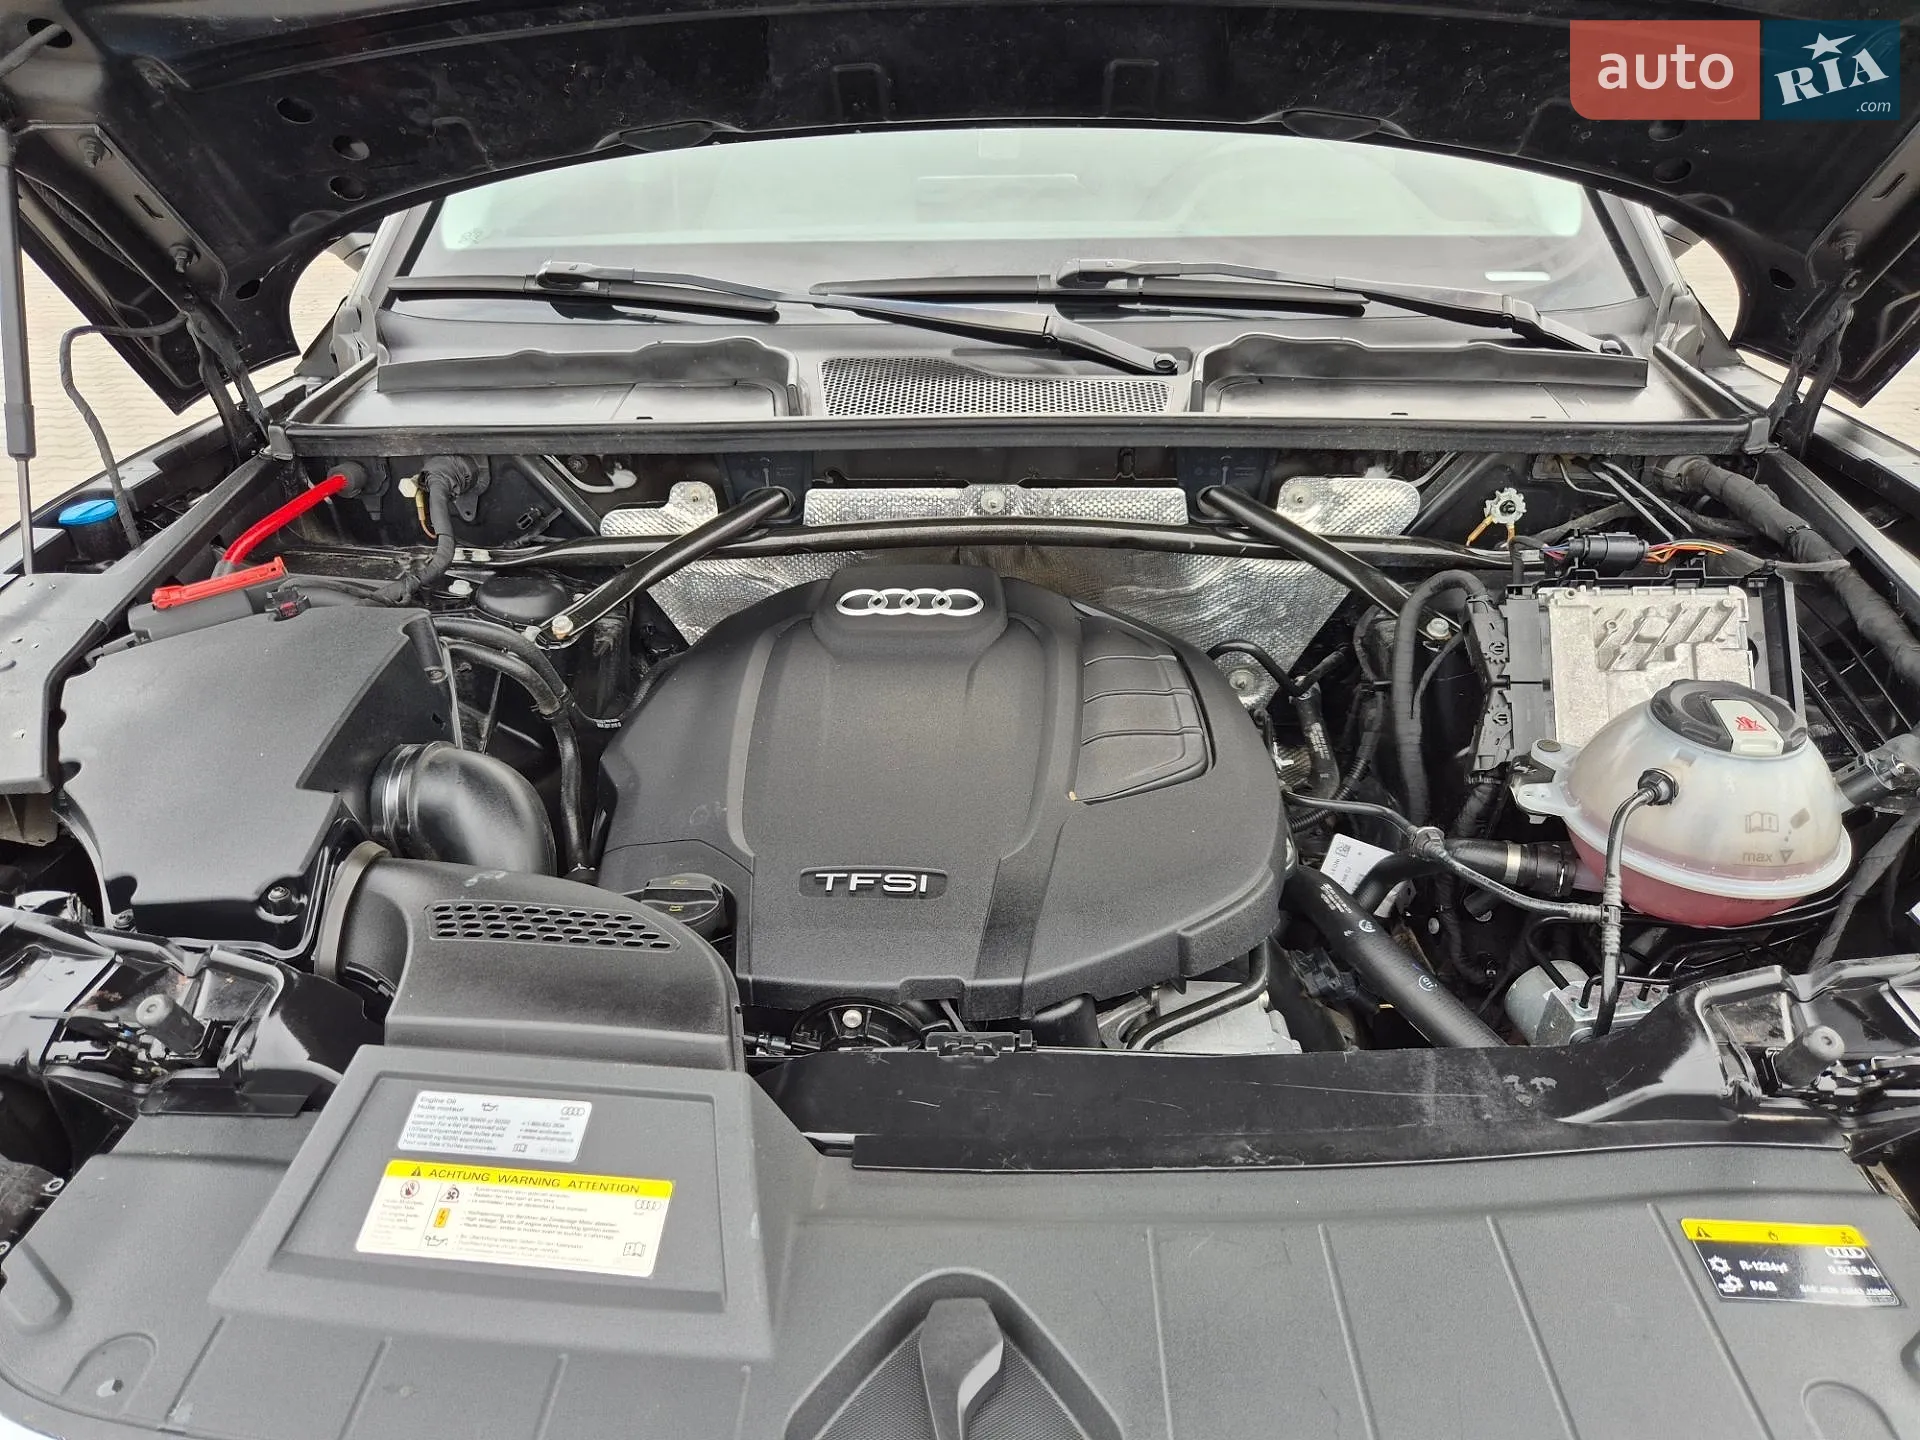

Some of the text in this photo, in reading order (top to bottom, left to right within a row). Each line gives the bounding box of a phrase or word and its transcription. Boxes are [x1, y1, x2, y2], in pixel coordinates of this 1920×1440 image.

[1742, 852, 1773, 863] max
[815, 872, 928, 894] TFSI
[420, 1096, 444, 1104] Engine
[428, 1168, 490, 1182] ACHTUNG
[498, 1173, 561, 1188] WARNING
[567, 1177, 641, 1193] ATTENTION
